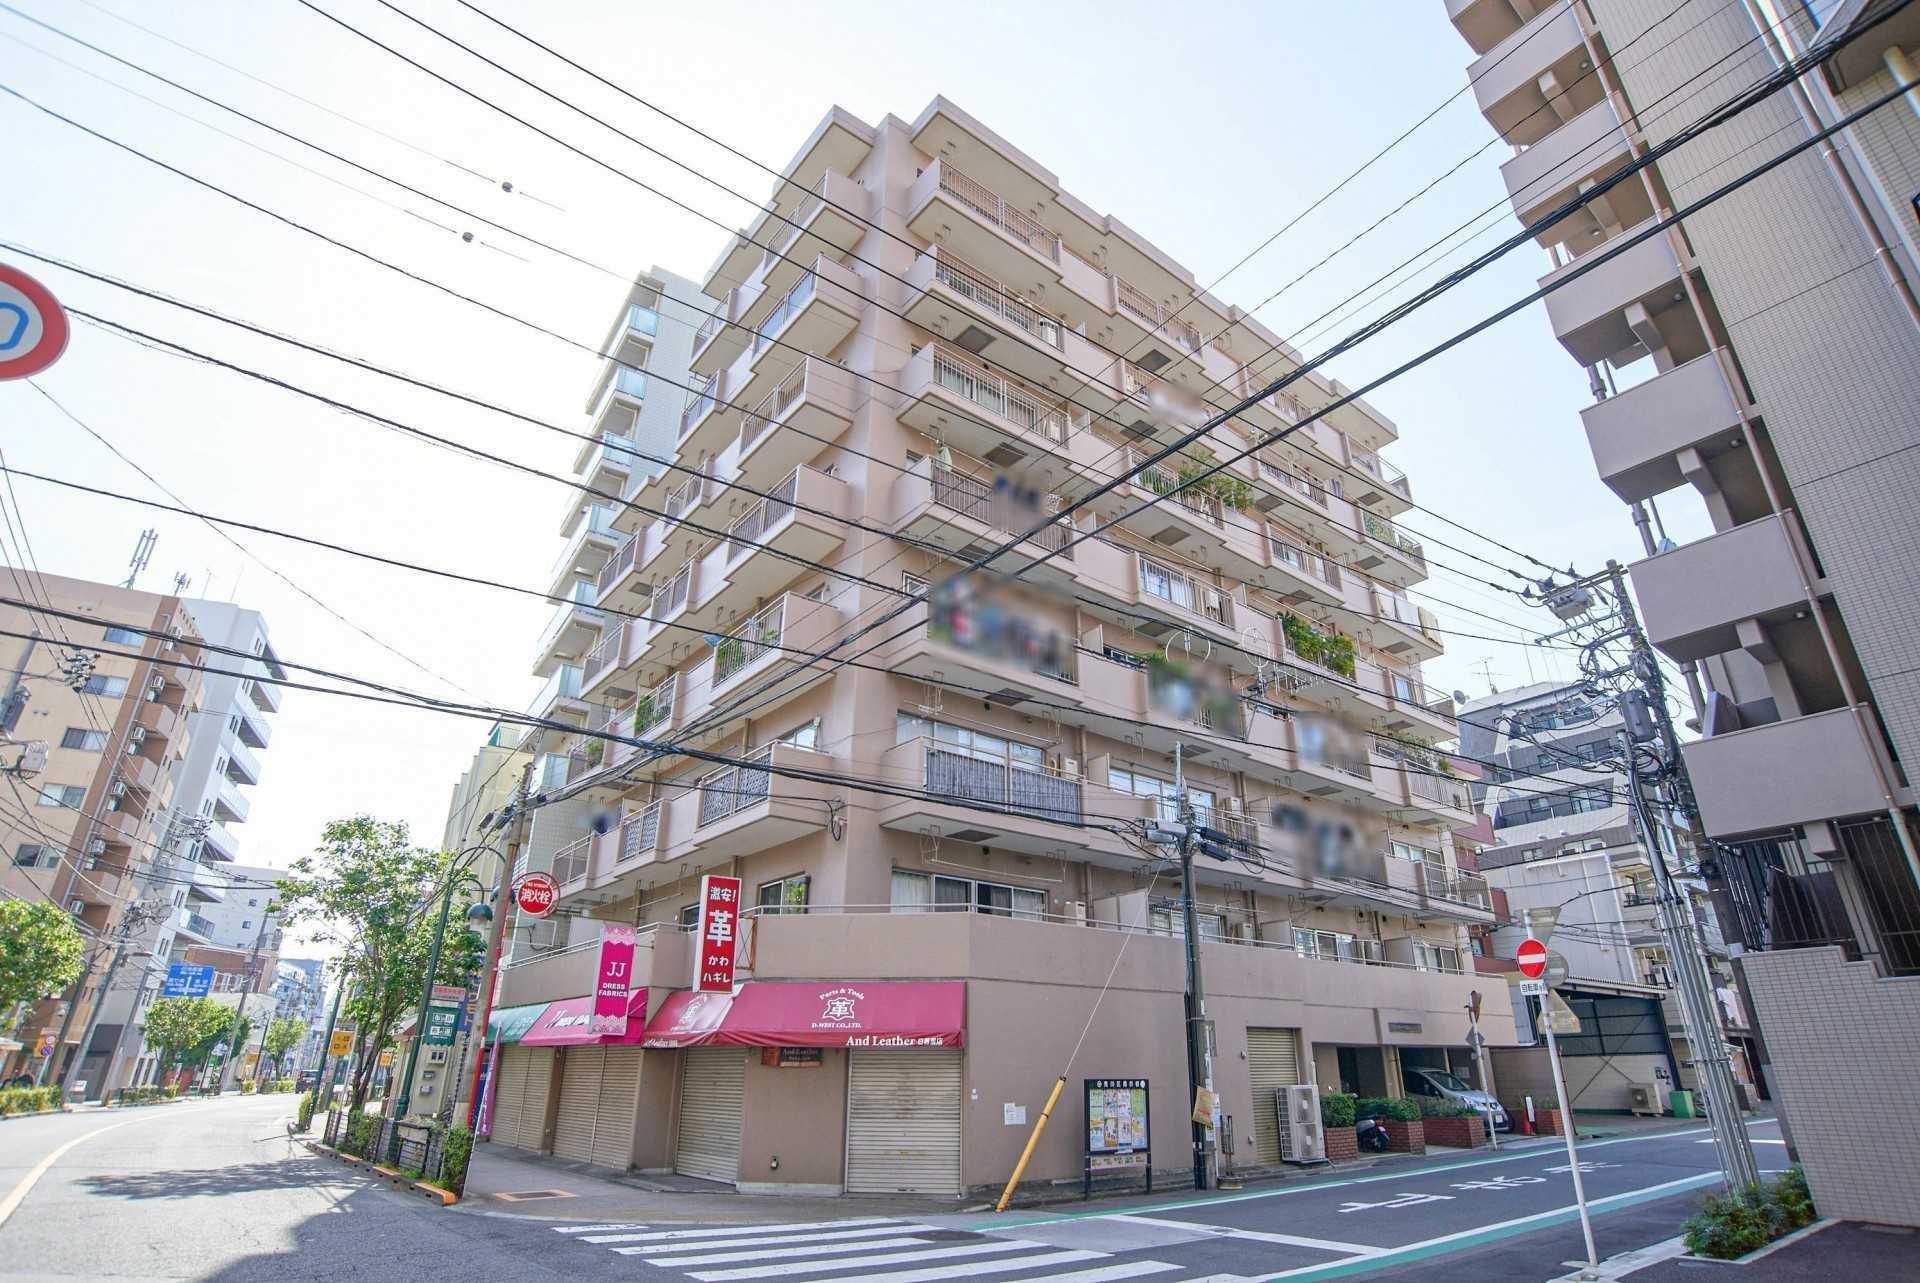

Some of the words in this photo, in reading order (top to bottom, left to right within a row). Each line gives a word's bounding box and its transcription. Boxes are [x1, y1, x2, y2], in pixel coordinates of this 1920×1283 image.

[520, 887, 552, 905] 消火栓
[706, 909, 733, 947] 革
[708, 955, 729, 967] かわ
[606, 961, 627, 977] JJ
[703, 972, 731, 984] ハギレ
[602, 982, 626, 990] DRESS
[599, 989, 628, 998] FABRICS
[819, 990, 839, 1001] Parts
[839, 987, 846, 995] &
[847, 987, 865, 1000] Tools
[830, 1000, 851, 1018] 革
[846, 1036, 870, 1047] And
[872, 1036, 914, 1047] Leather
